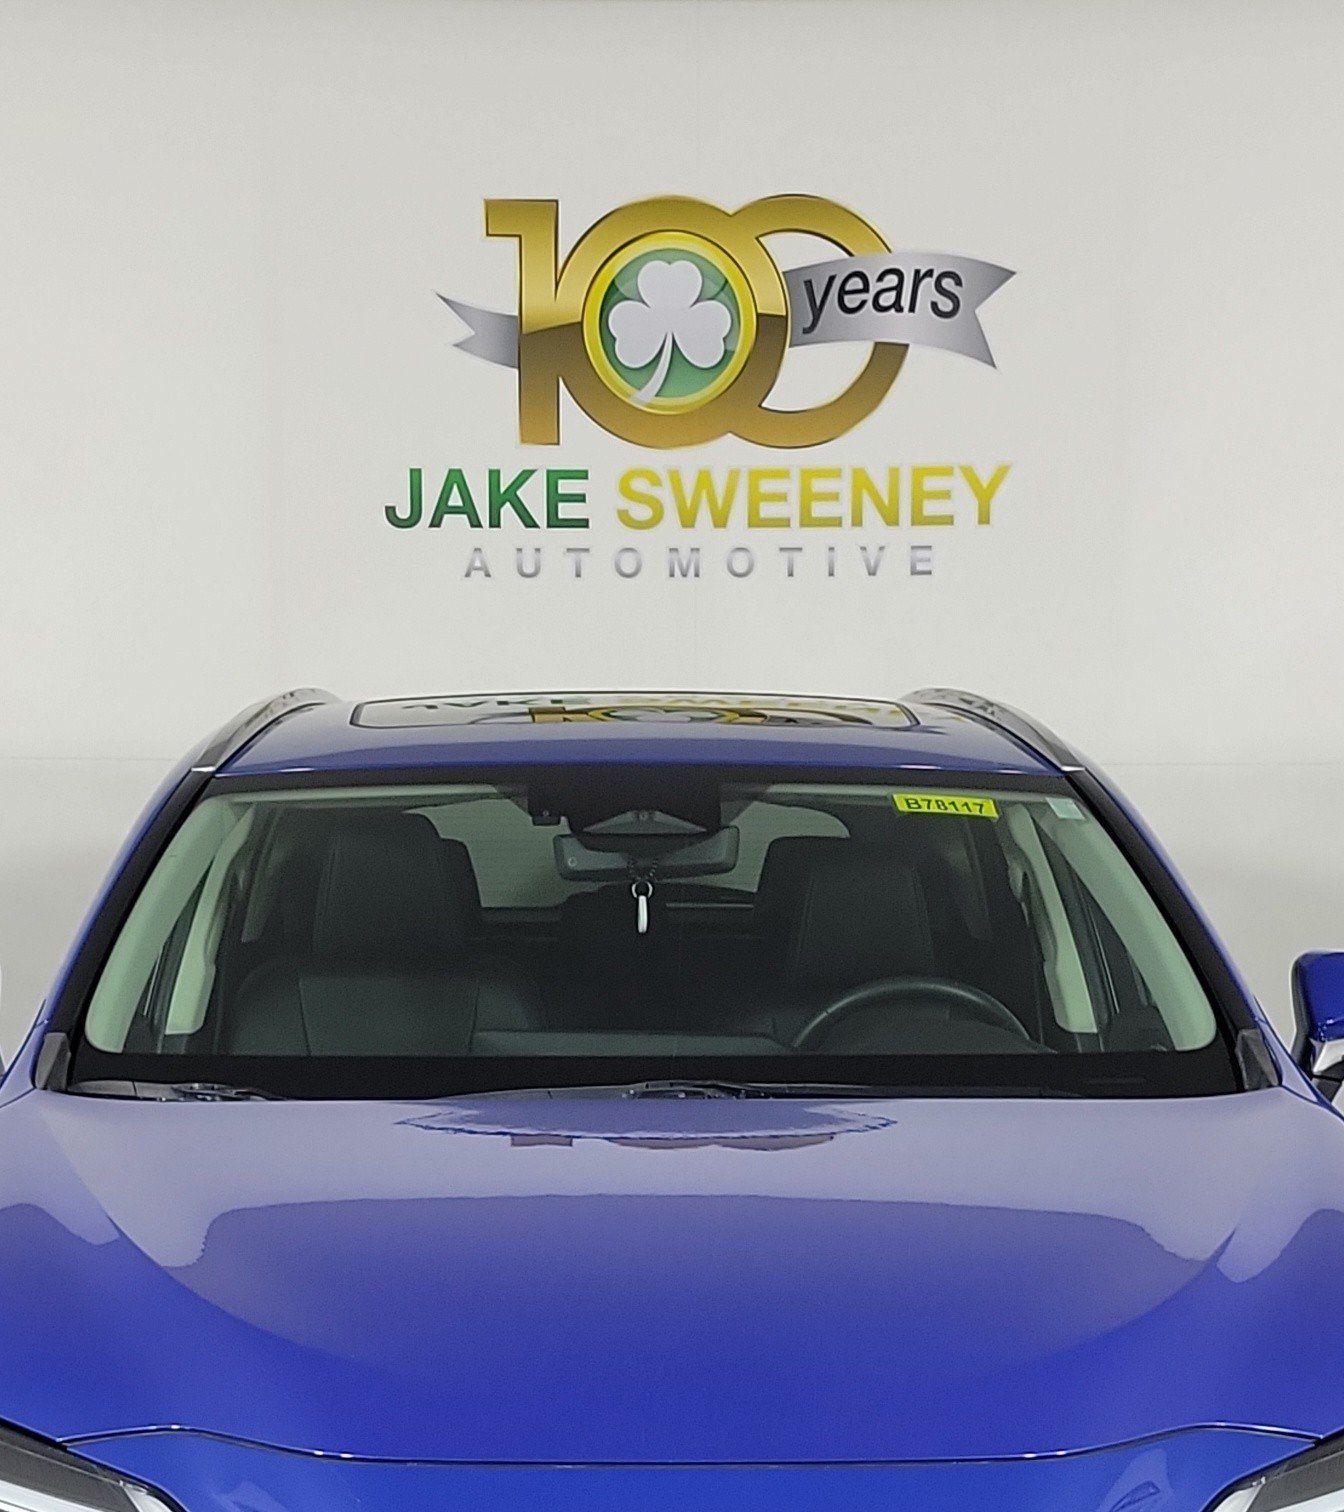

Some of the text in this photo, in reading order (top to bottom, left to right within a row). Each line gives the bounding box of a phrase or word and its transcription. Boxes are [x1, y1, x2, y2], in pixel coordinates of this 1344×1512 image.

[482, 194, 912, 450] 100
[801, 266, 964, 335] years
[384, 463, 1012, 530] JAKE SWEENEY
[463, 544, 934, 579] AUTOMOTIVE
[904, 798, 984, 815] B78117
